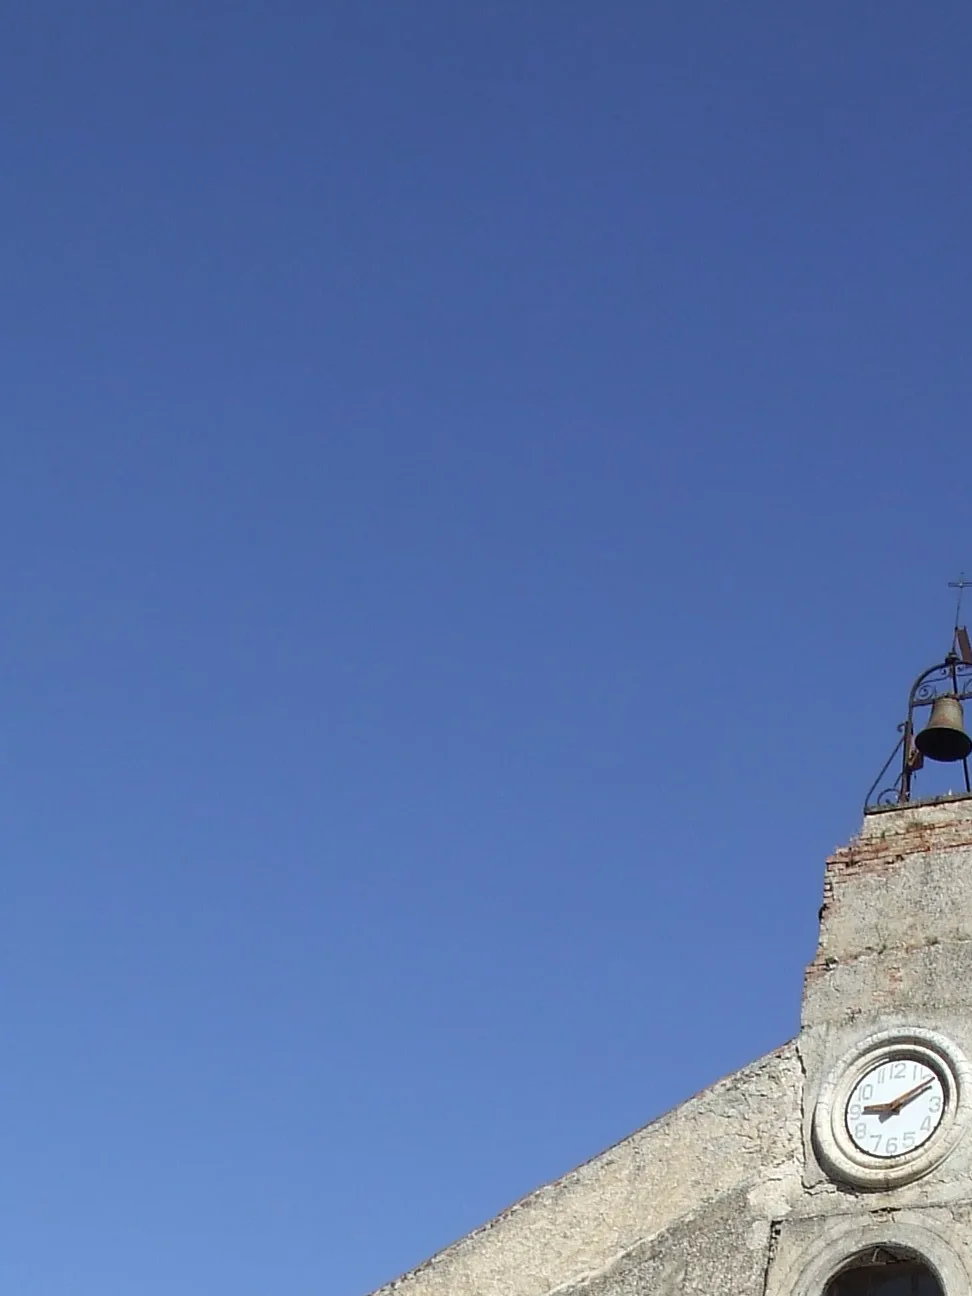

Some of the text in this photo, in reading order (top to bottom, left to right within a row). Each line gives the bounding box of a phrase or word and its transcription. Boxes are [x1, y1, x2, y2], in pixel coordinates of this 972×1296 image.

[878, 1068, 885, 1084] 11
[889, 1062, 907, 1080] 12
[858, 1084, 873, 1101] 10
[850, 1104, 861, 1120] 9
[929, 1096, 941, 1113] 3
[855, 1123, 866, 1139] 8
[920, 1116, 931, 1131] 4
[870, 1134, 882, 1152] 7
[886, 1137, 898, 1153] 6
[902, 1131, 915, 1148] 5
